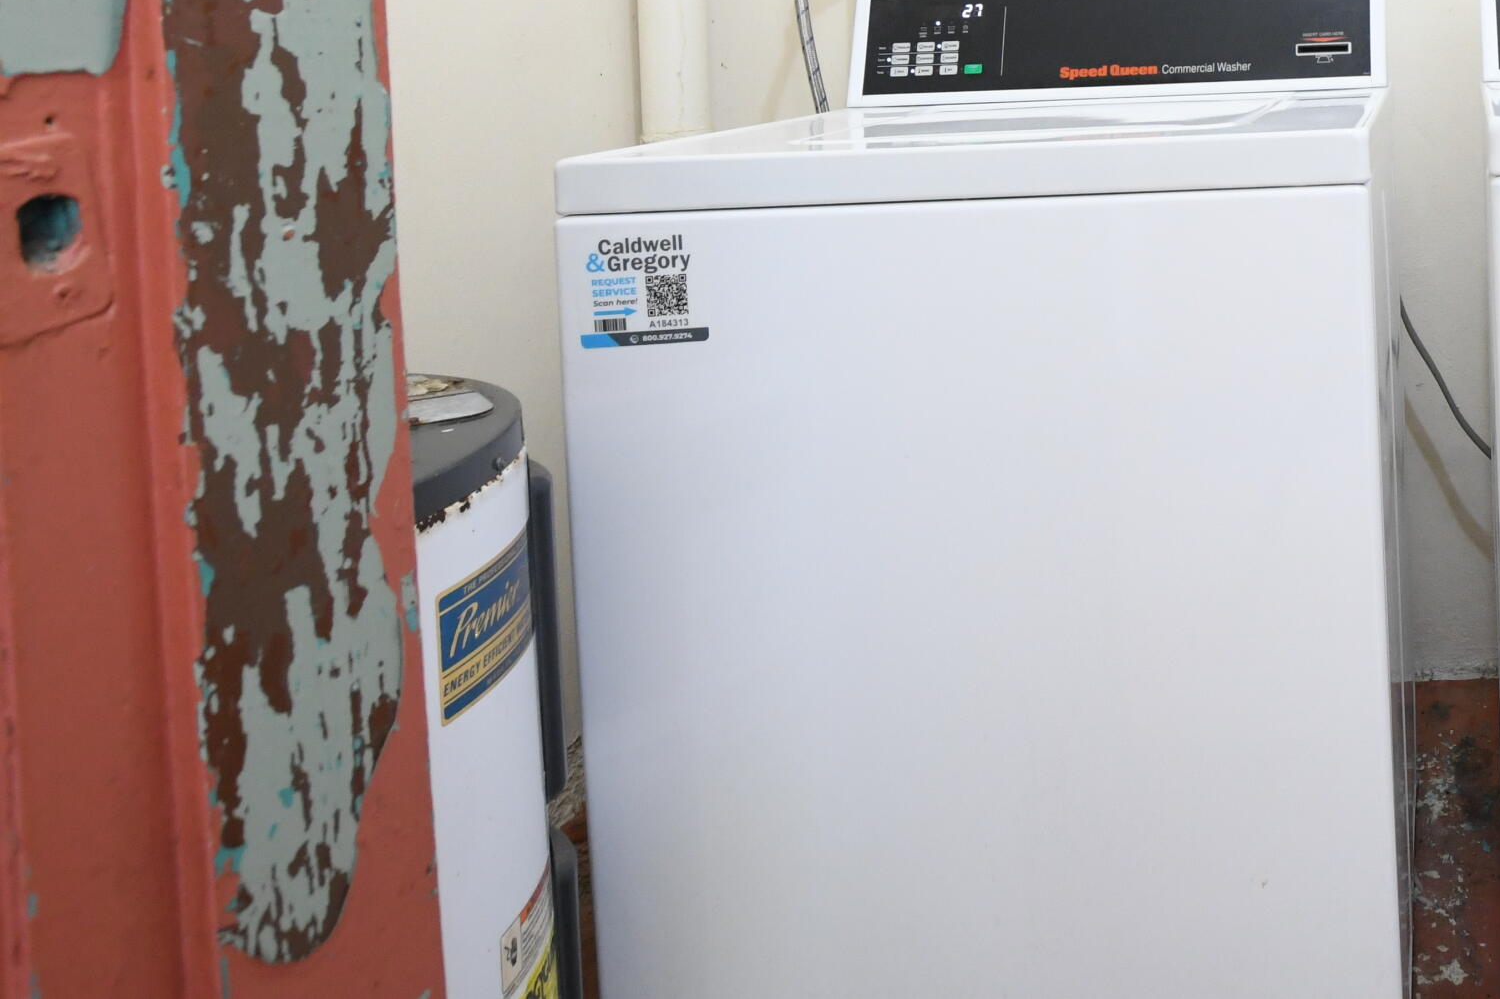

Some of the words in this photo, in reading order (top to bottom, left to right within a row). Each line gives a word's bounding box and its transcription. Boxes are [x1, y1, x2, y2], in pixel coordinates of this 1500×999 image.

[962, 3, 984, 18] 27
[1059, 65, 1107, 80] Speed
[1109, 64, 1158, 76] Queen
[1161, 63, 1215, 75] Commercial
[1217, 61, 1251, 73] Washer
[598, 234, 683, 255] Caldwell
[592, 277, 636, 287] REQUEST
[592, 287, 637, 297] SERVICE
[650, 318, 689, 328] A184313
[450, 578, 521, 659] Premier
[444, 659, 480, 697] ENERGY
